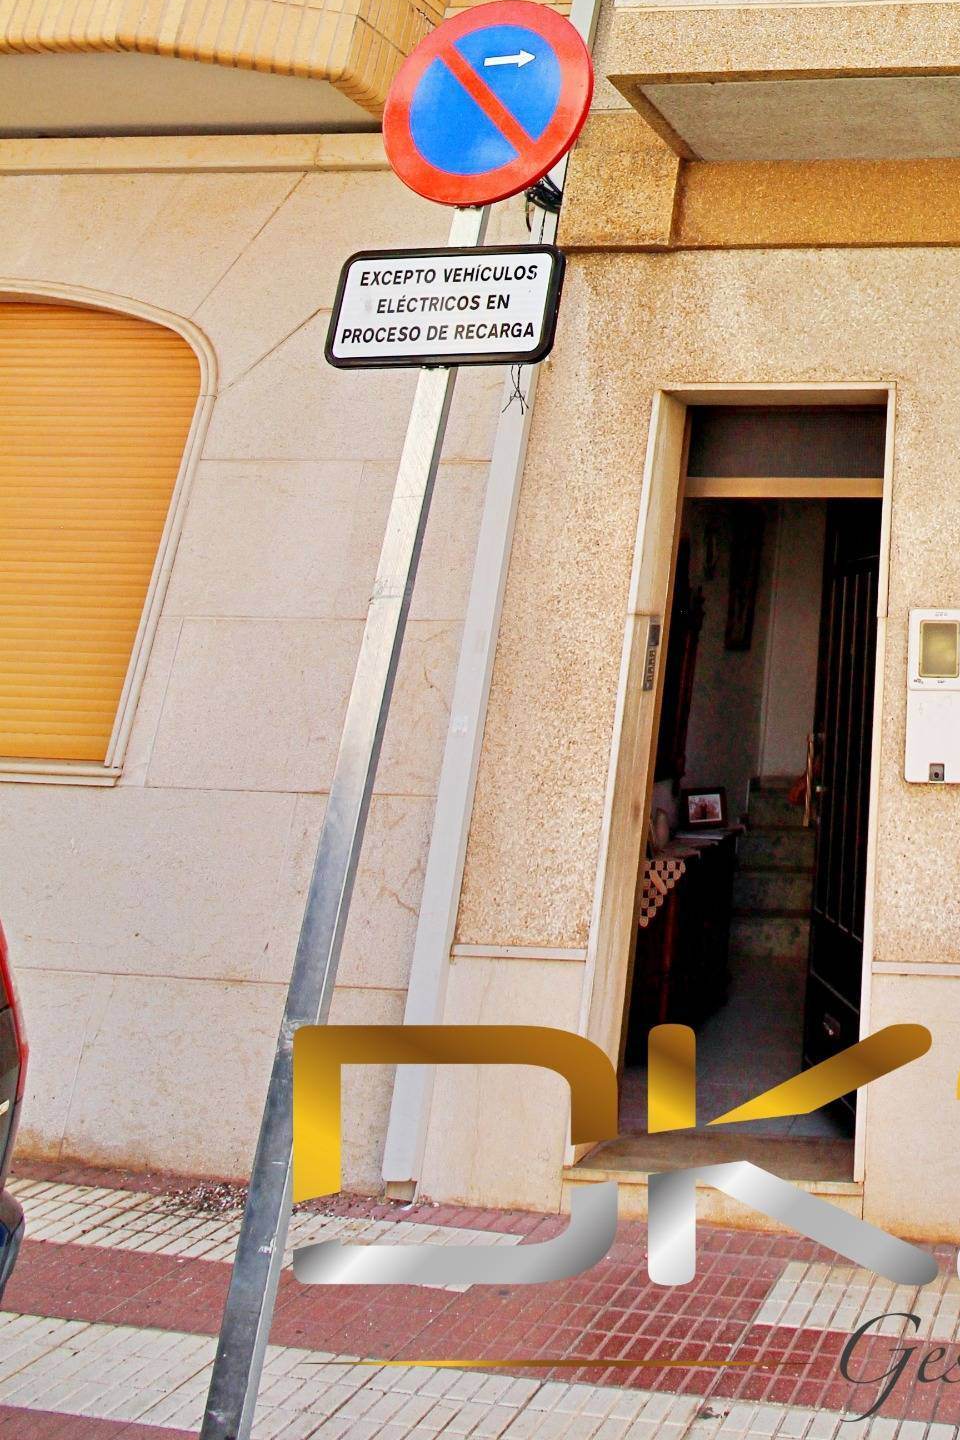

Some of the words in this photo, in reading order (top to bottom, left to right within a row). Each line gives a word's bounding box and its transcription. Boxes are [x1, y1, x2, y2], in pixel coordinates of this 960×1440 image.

[360, 268, 437, 287] EXCEPTO
[443, 263, 539, 284] VEHÍCULOS
[376, 294, 481, 314] ELÉCTRICOS
[486, 293, 511, 310] EN
[340, 325, 421, 344] PROCESO
[426, 324, 449, 341] DE
[453, 322, 535, 340] RECARGA
